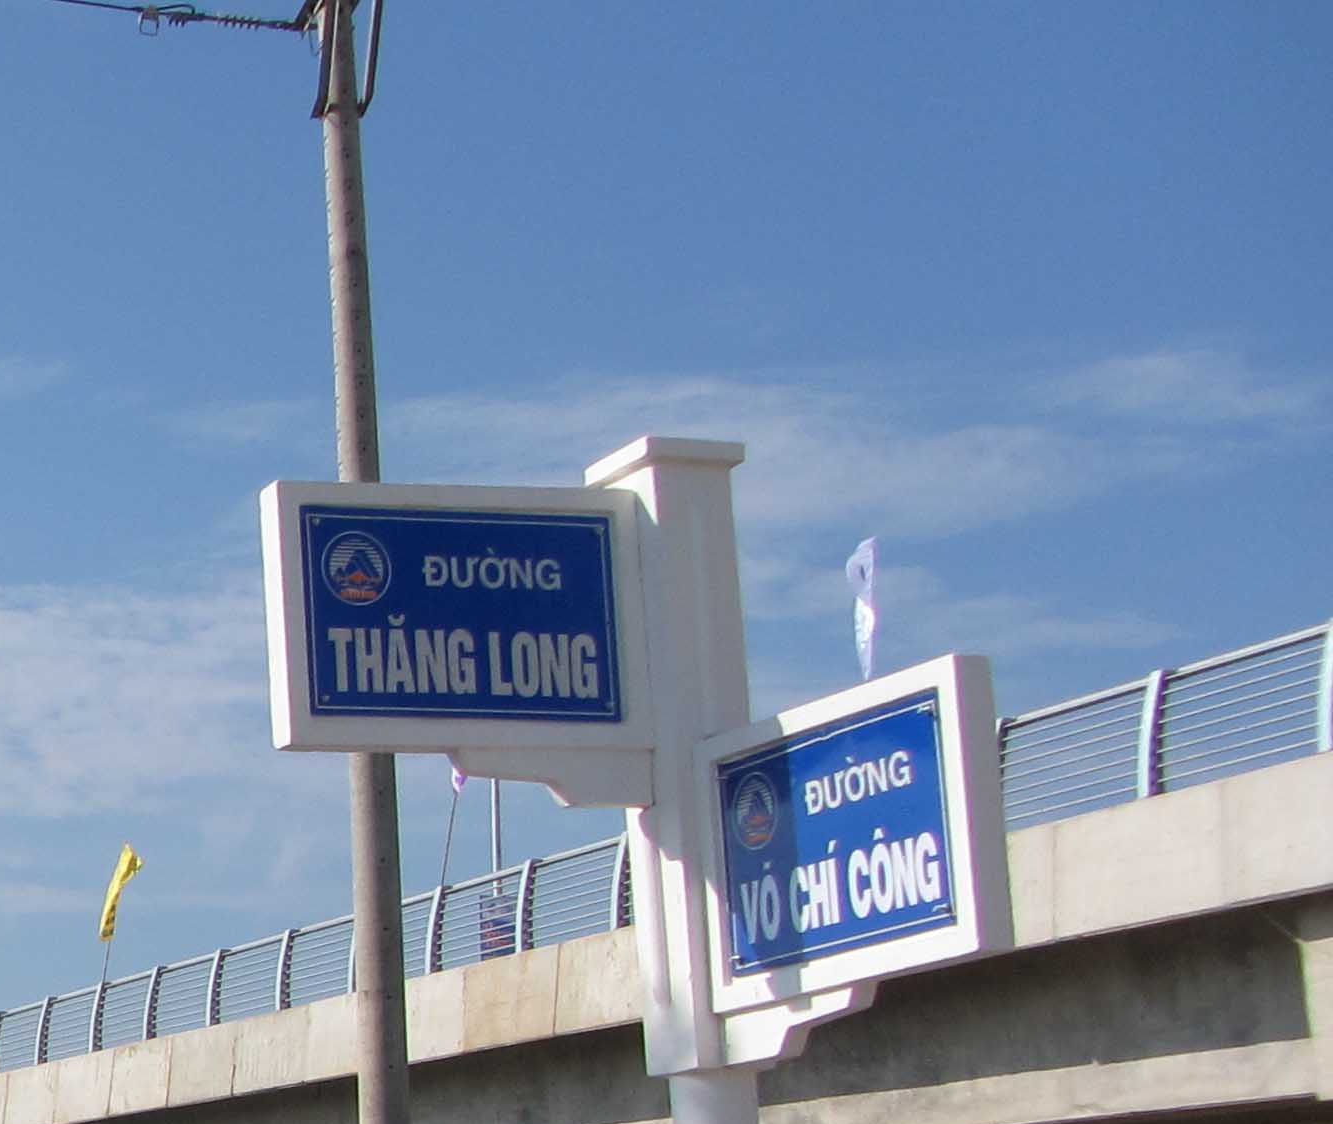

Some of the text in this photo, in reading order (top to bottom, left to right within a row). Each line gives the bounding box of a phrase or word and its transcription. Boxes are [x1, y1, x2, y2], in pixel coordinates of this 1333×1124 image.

[422, 547, 563, 591] ĐƯỜNG
[327, 613, 599, 699] THĂNG LONG
[804, 751, 912, 816] ĐƯỜNG
[789, 840, 840, 934] CHÍ
[848, 827, 942, 919] CÔNG
